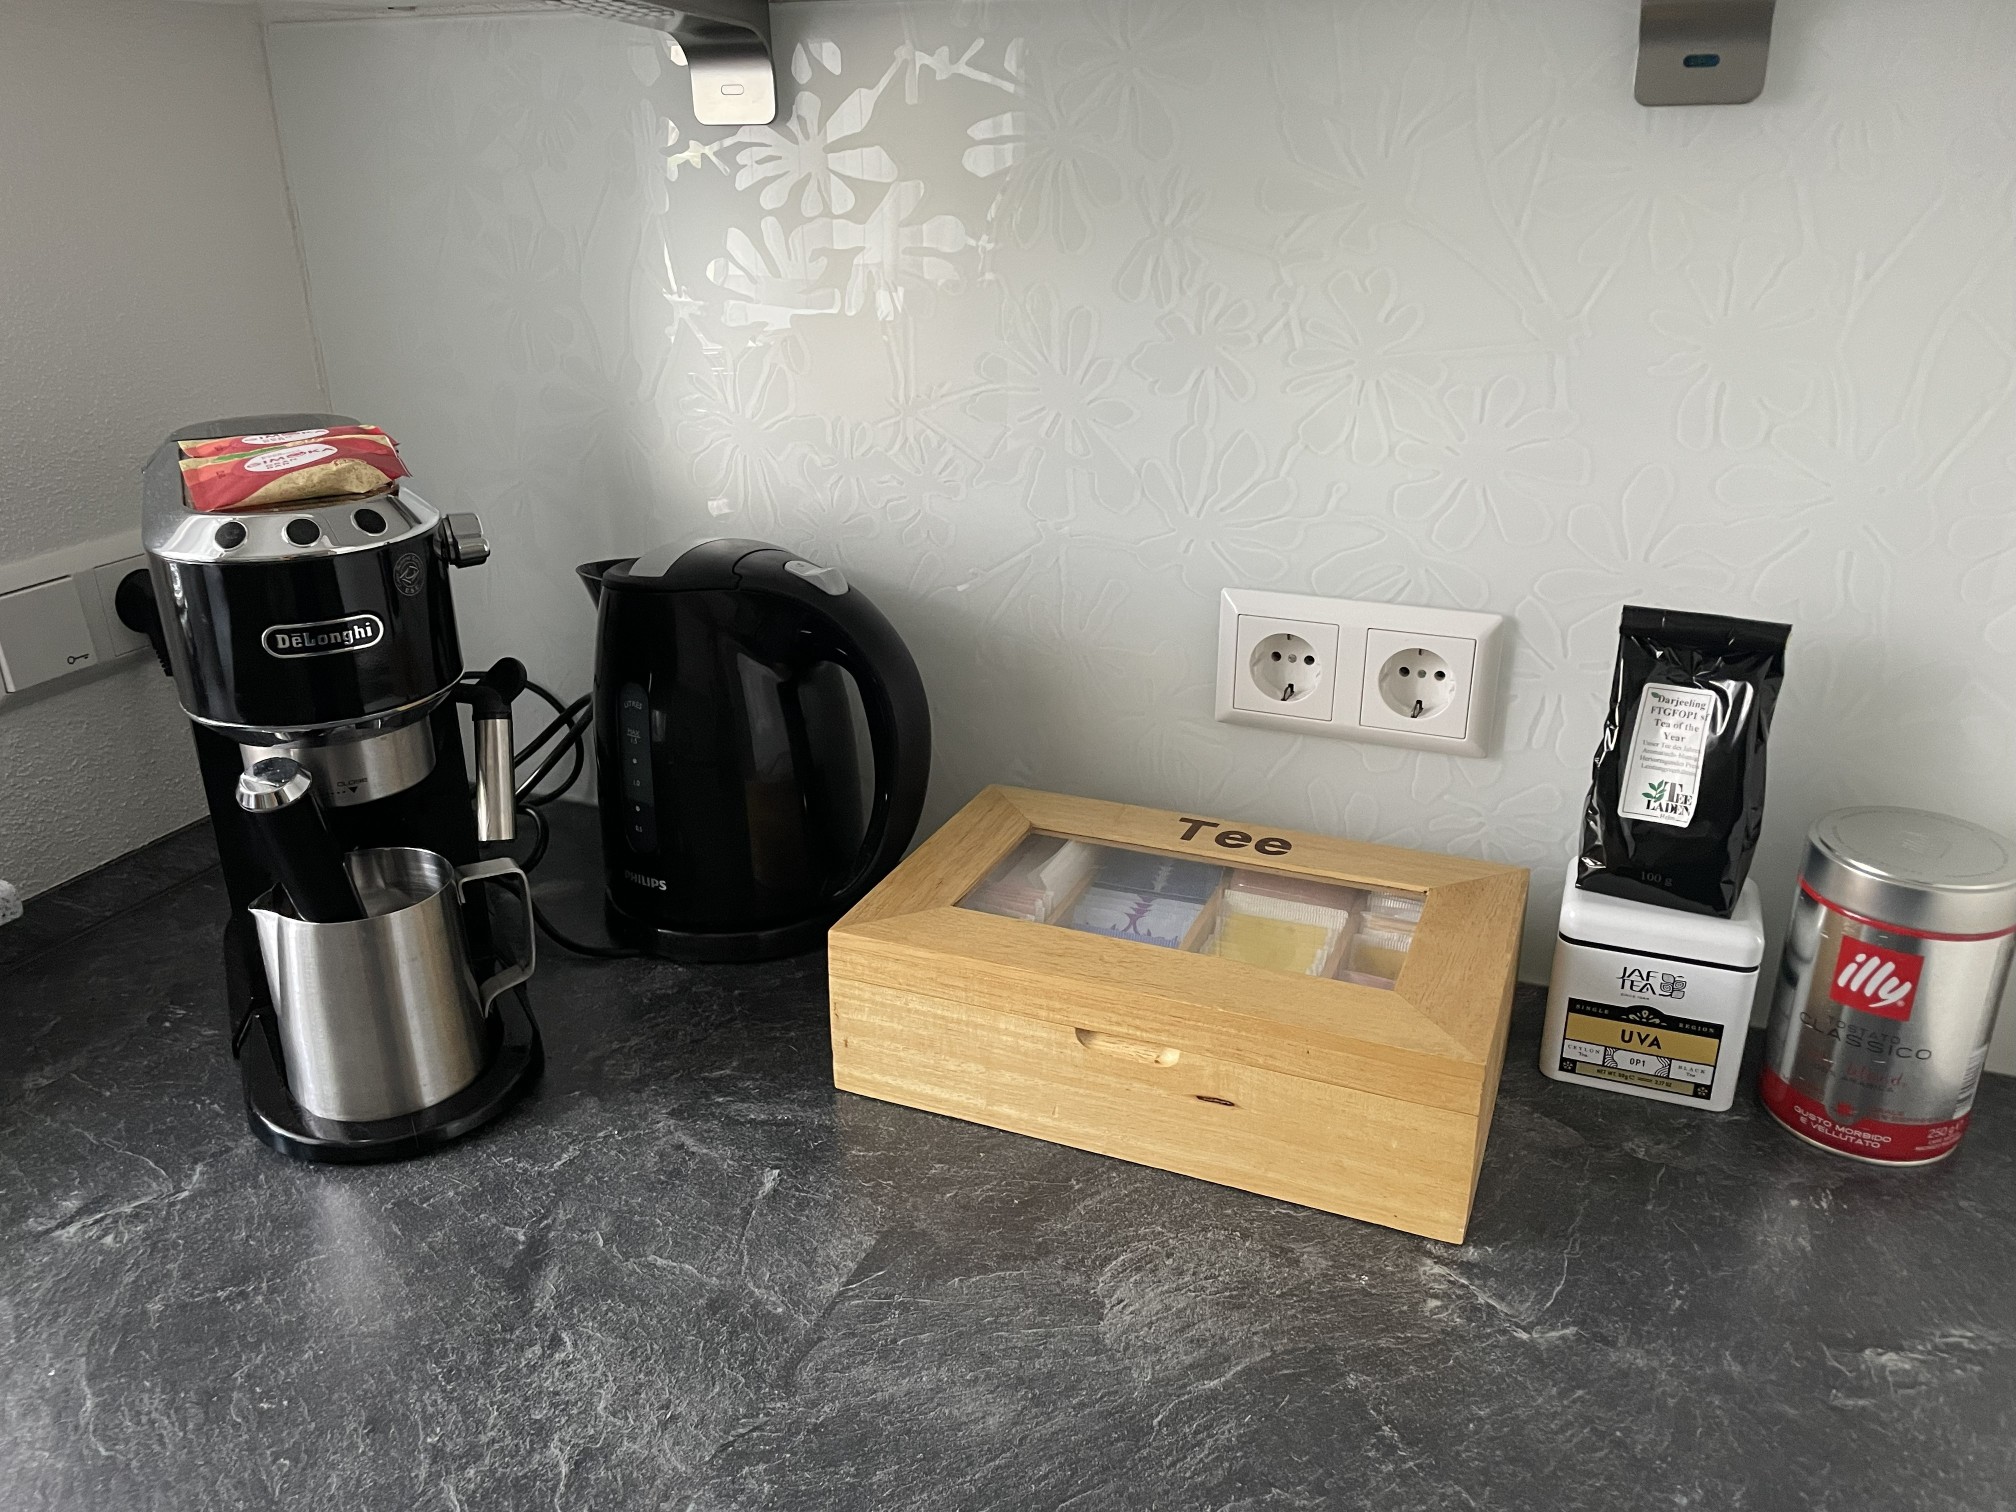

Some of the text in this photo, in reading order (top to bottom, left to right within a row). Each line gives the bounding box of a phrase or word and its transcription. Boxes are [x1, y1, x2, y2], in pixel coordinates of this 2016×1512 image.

[1658, 694, 1707, 710] Darjeeling
[1655, 718, 1700, 733] Tea of the
[1664, 732, 1687, 742] Year
[1646, 799, 1691, 817] LADEN
[1179, 817, 1292, 855] Tee
[624, 869, 667, 891] PHILIPS
[1641, 871, 1673, 887] 100 g
[1620, 978, 1657, 996] TEA
[1837, 953, 1912, 1008] illy
[1575, 1004, 1715, 1033] SINGLE REGION
[1620, 1029, 1662, 1050] UVA
[1799, 1011, 1932, 1060] CLASSICO
[1827, 1015, 1901, 1044] TOSTATO
[1567, 1044, 1601, 1055] CEYLON
[1677, 1065, 1707, 1075] BLACK
[1794, 1105, 1892, 1143] GUSTO MORBIDO
[1800, 1116, 1881, 1148] E VELLUTATO
